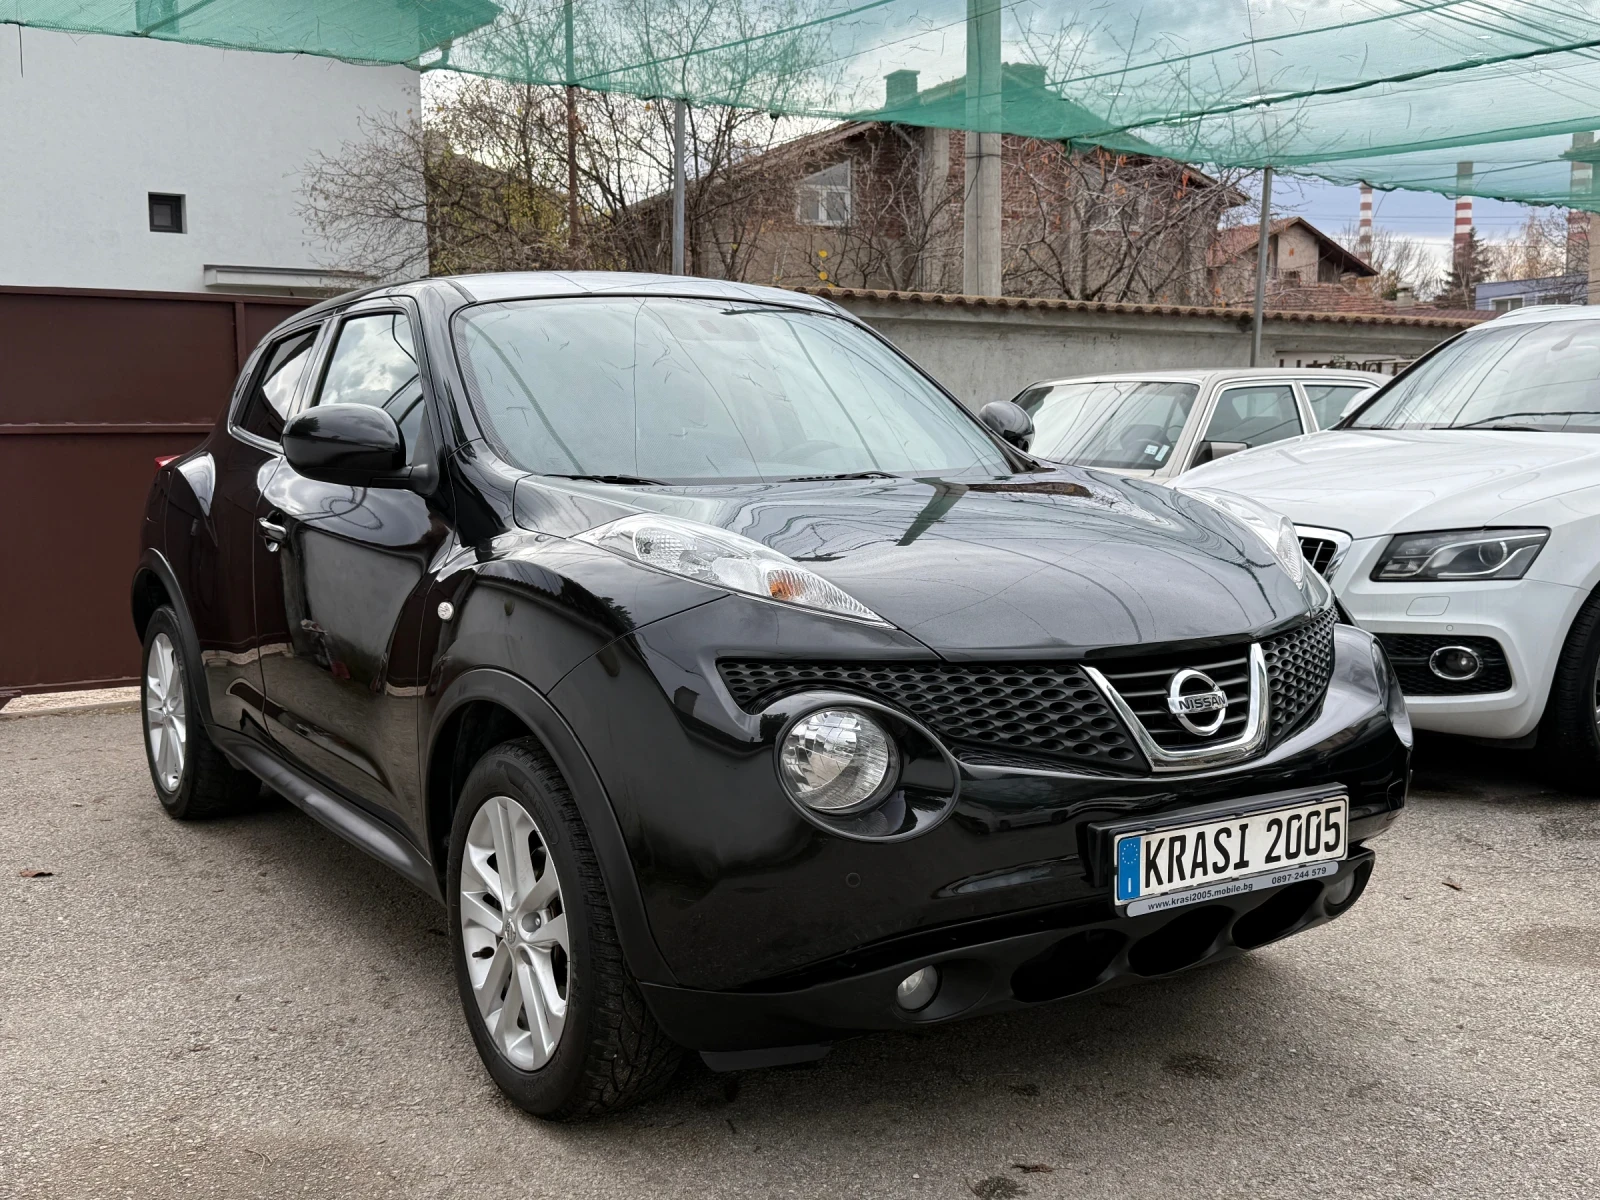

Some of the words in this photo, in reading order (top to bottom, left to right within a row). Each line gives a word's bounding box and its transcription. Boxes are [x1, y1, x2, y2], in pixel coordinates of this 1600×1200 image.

[1178, 695, 1226, 710] NISSAN
[1144, 823, 1250, 889] KRASI
[1265, 806, 1342, 864] 2005
[1147, 882, 1254, 911] www.krasi2005.mobile.bg
[1311, 866, 1327, 876] 579
